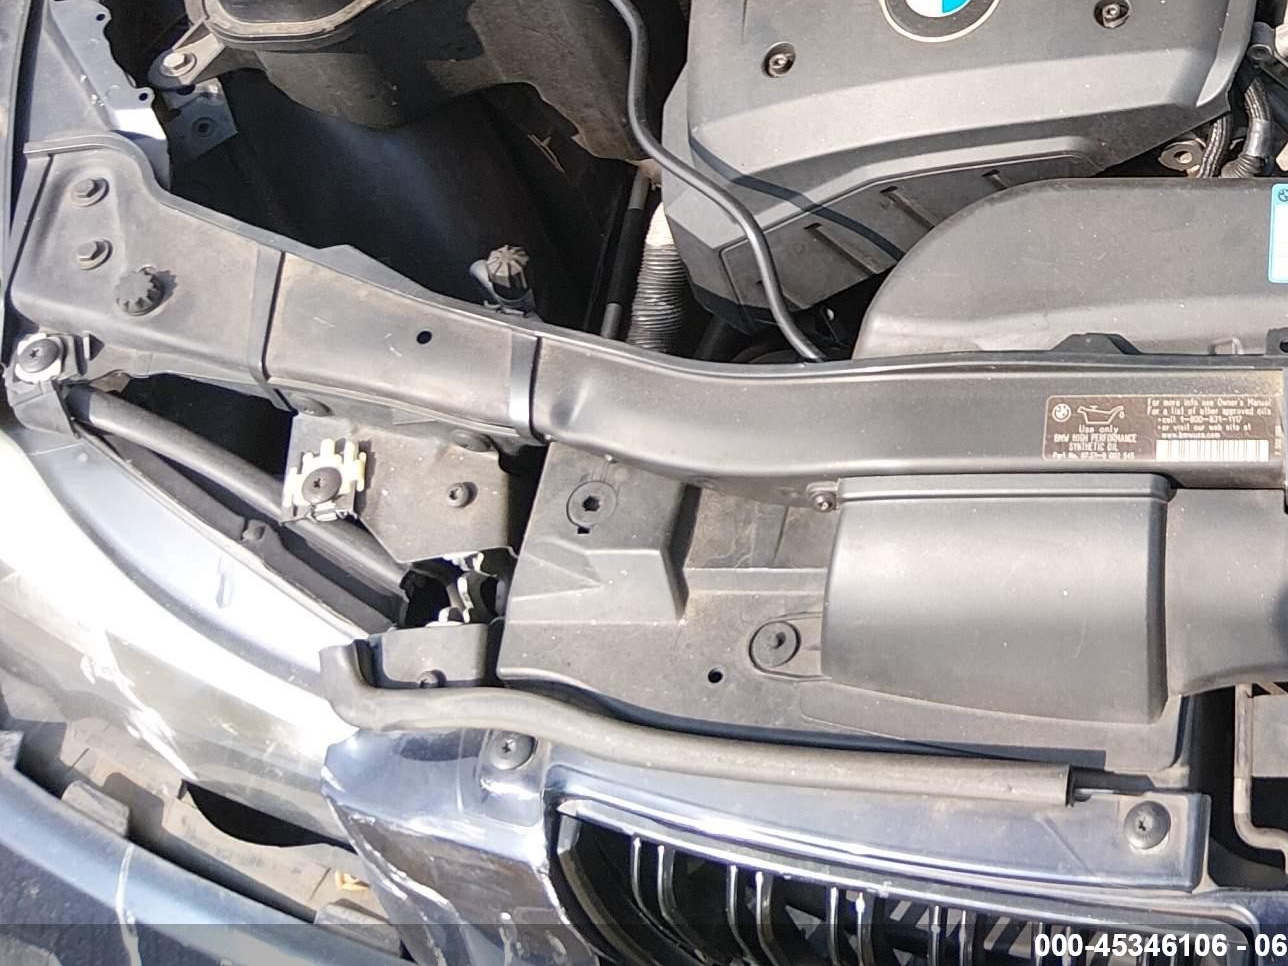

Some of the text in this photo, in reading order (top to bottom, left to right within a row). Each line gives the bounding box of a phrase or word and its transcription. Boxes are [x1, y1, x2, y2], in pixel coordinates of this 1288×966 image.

[1147, 398, 1160, 407] For
[1184, 398, 1198, 407] info
[1217, 397, 1244, 406] Owner's
[1247, 397, 1272, 406] Manual
[1147, 406, 1160, 415] For
[1171, 406, 1184, 415] list
[1188, 406, 1196, 415] of
[1200, 406, 1218, 415] other
[1222, 407, 1254, 416] approved
[1257, 407, 1271, 415] oils
[1079, 424, 1119, 434] Use only
[1173, 423, 1190, 431] visit
[1209, 423, 1222, 431] web
[1226, 423, 1240, 431] site
[1054, 434, 1137, 443] BMW HIGH PERFORMANCE
[1068, 442, 1119, 451] SYNTHETIC OIL
